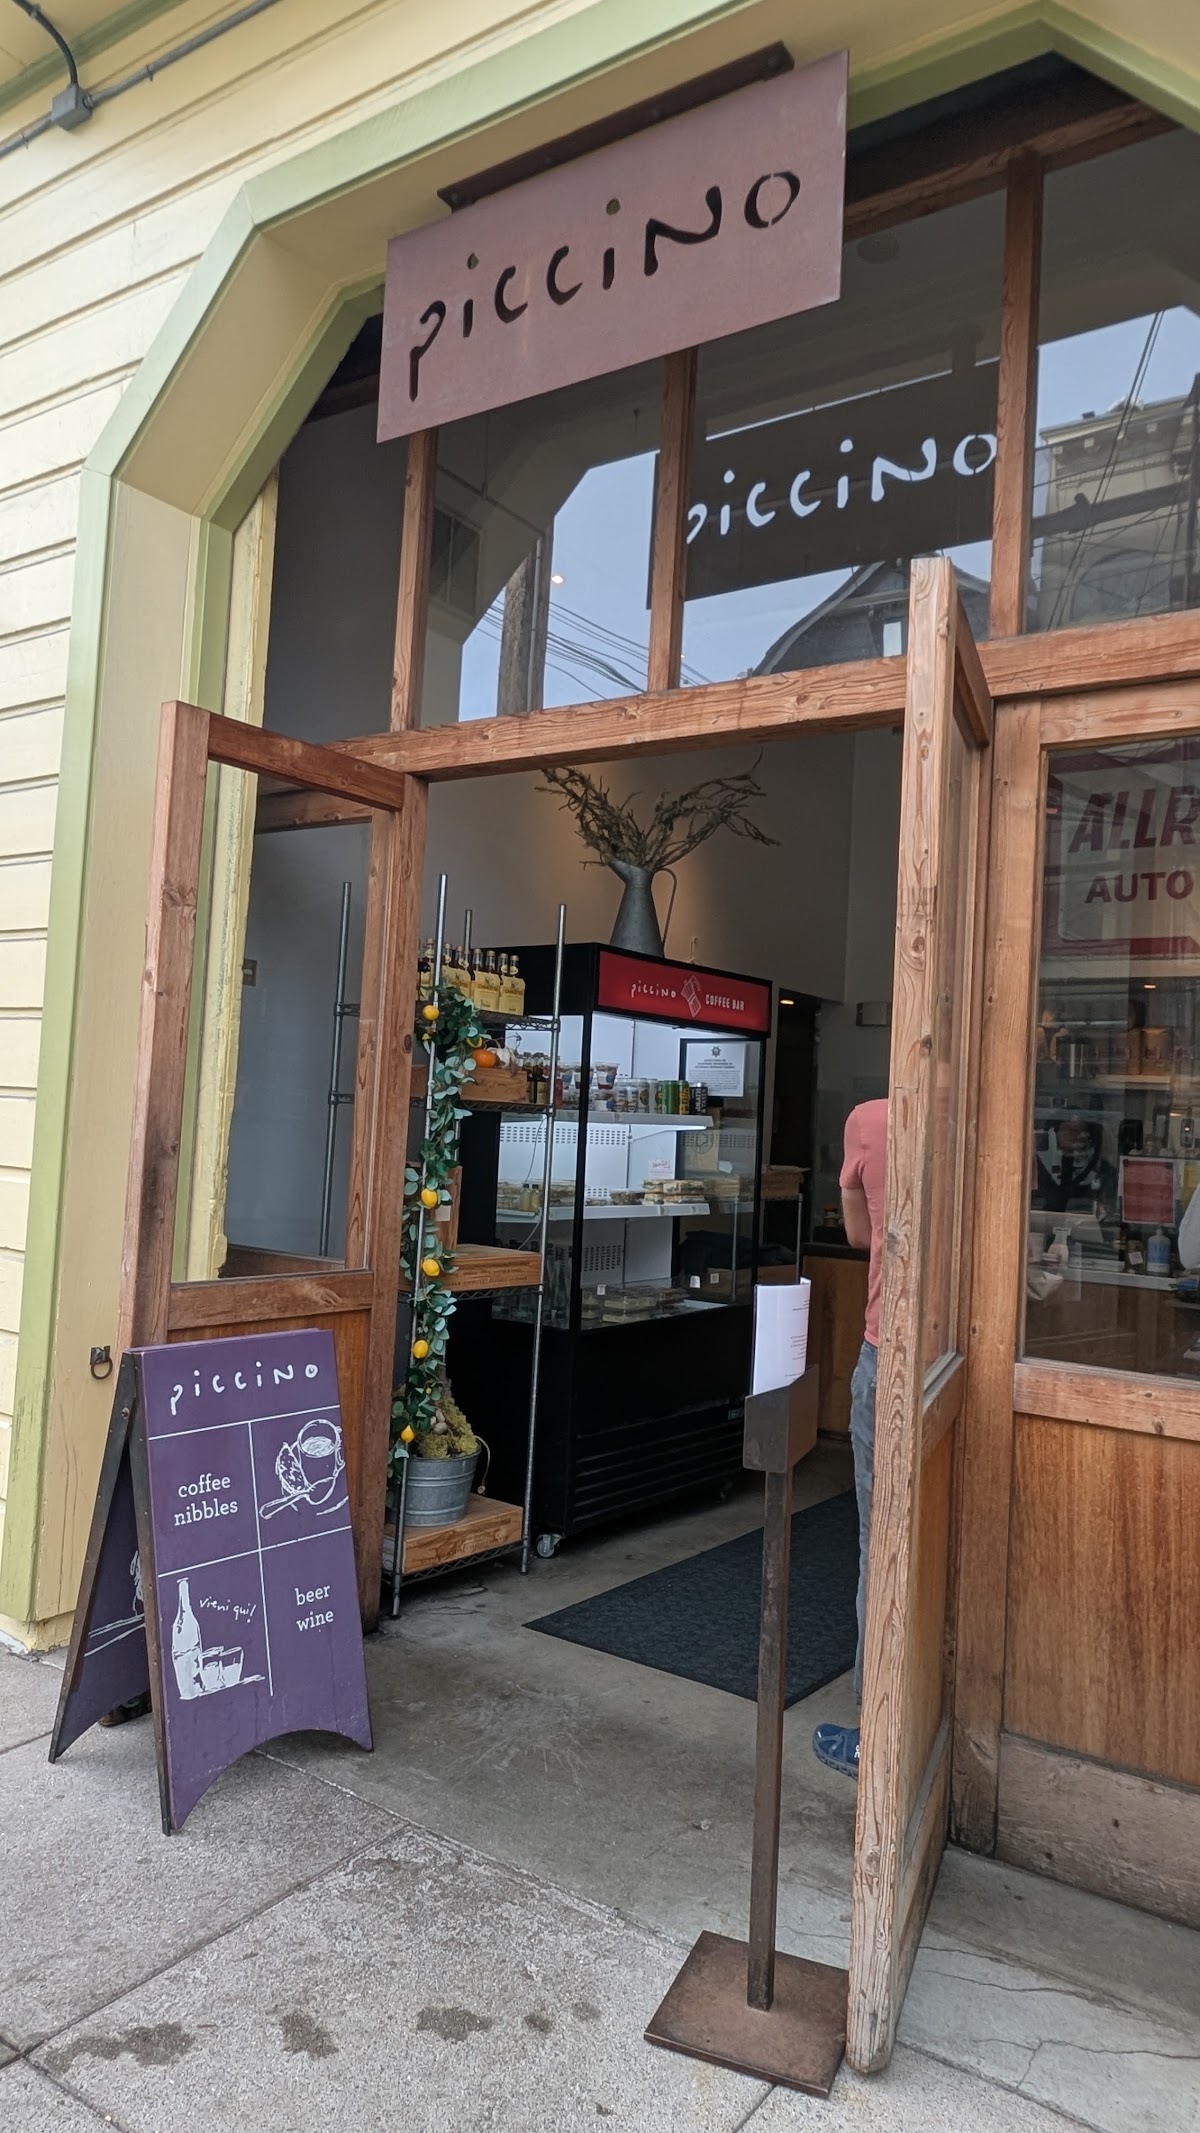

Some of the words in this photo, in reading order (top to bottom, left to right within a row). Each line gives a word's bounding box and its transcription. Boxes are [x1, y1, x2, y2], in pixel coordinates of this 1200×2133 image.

[1085, 869, 1195, 904] AUTO
[705, 994, 731, 1010] COFFEE
[732, 999, 745, 1012] BAR
[178, 1472, 231, 1499] coffee
[174, 1498, 238, 1527] nibbles
[294, 1585, 331, 1606] beer
[199, 1596, 231, 1612] vieni
[233, 1602, 257, 1624] qui!
[296, 1610, 334, 1632] wine
